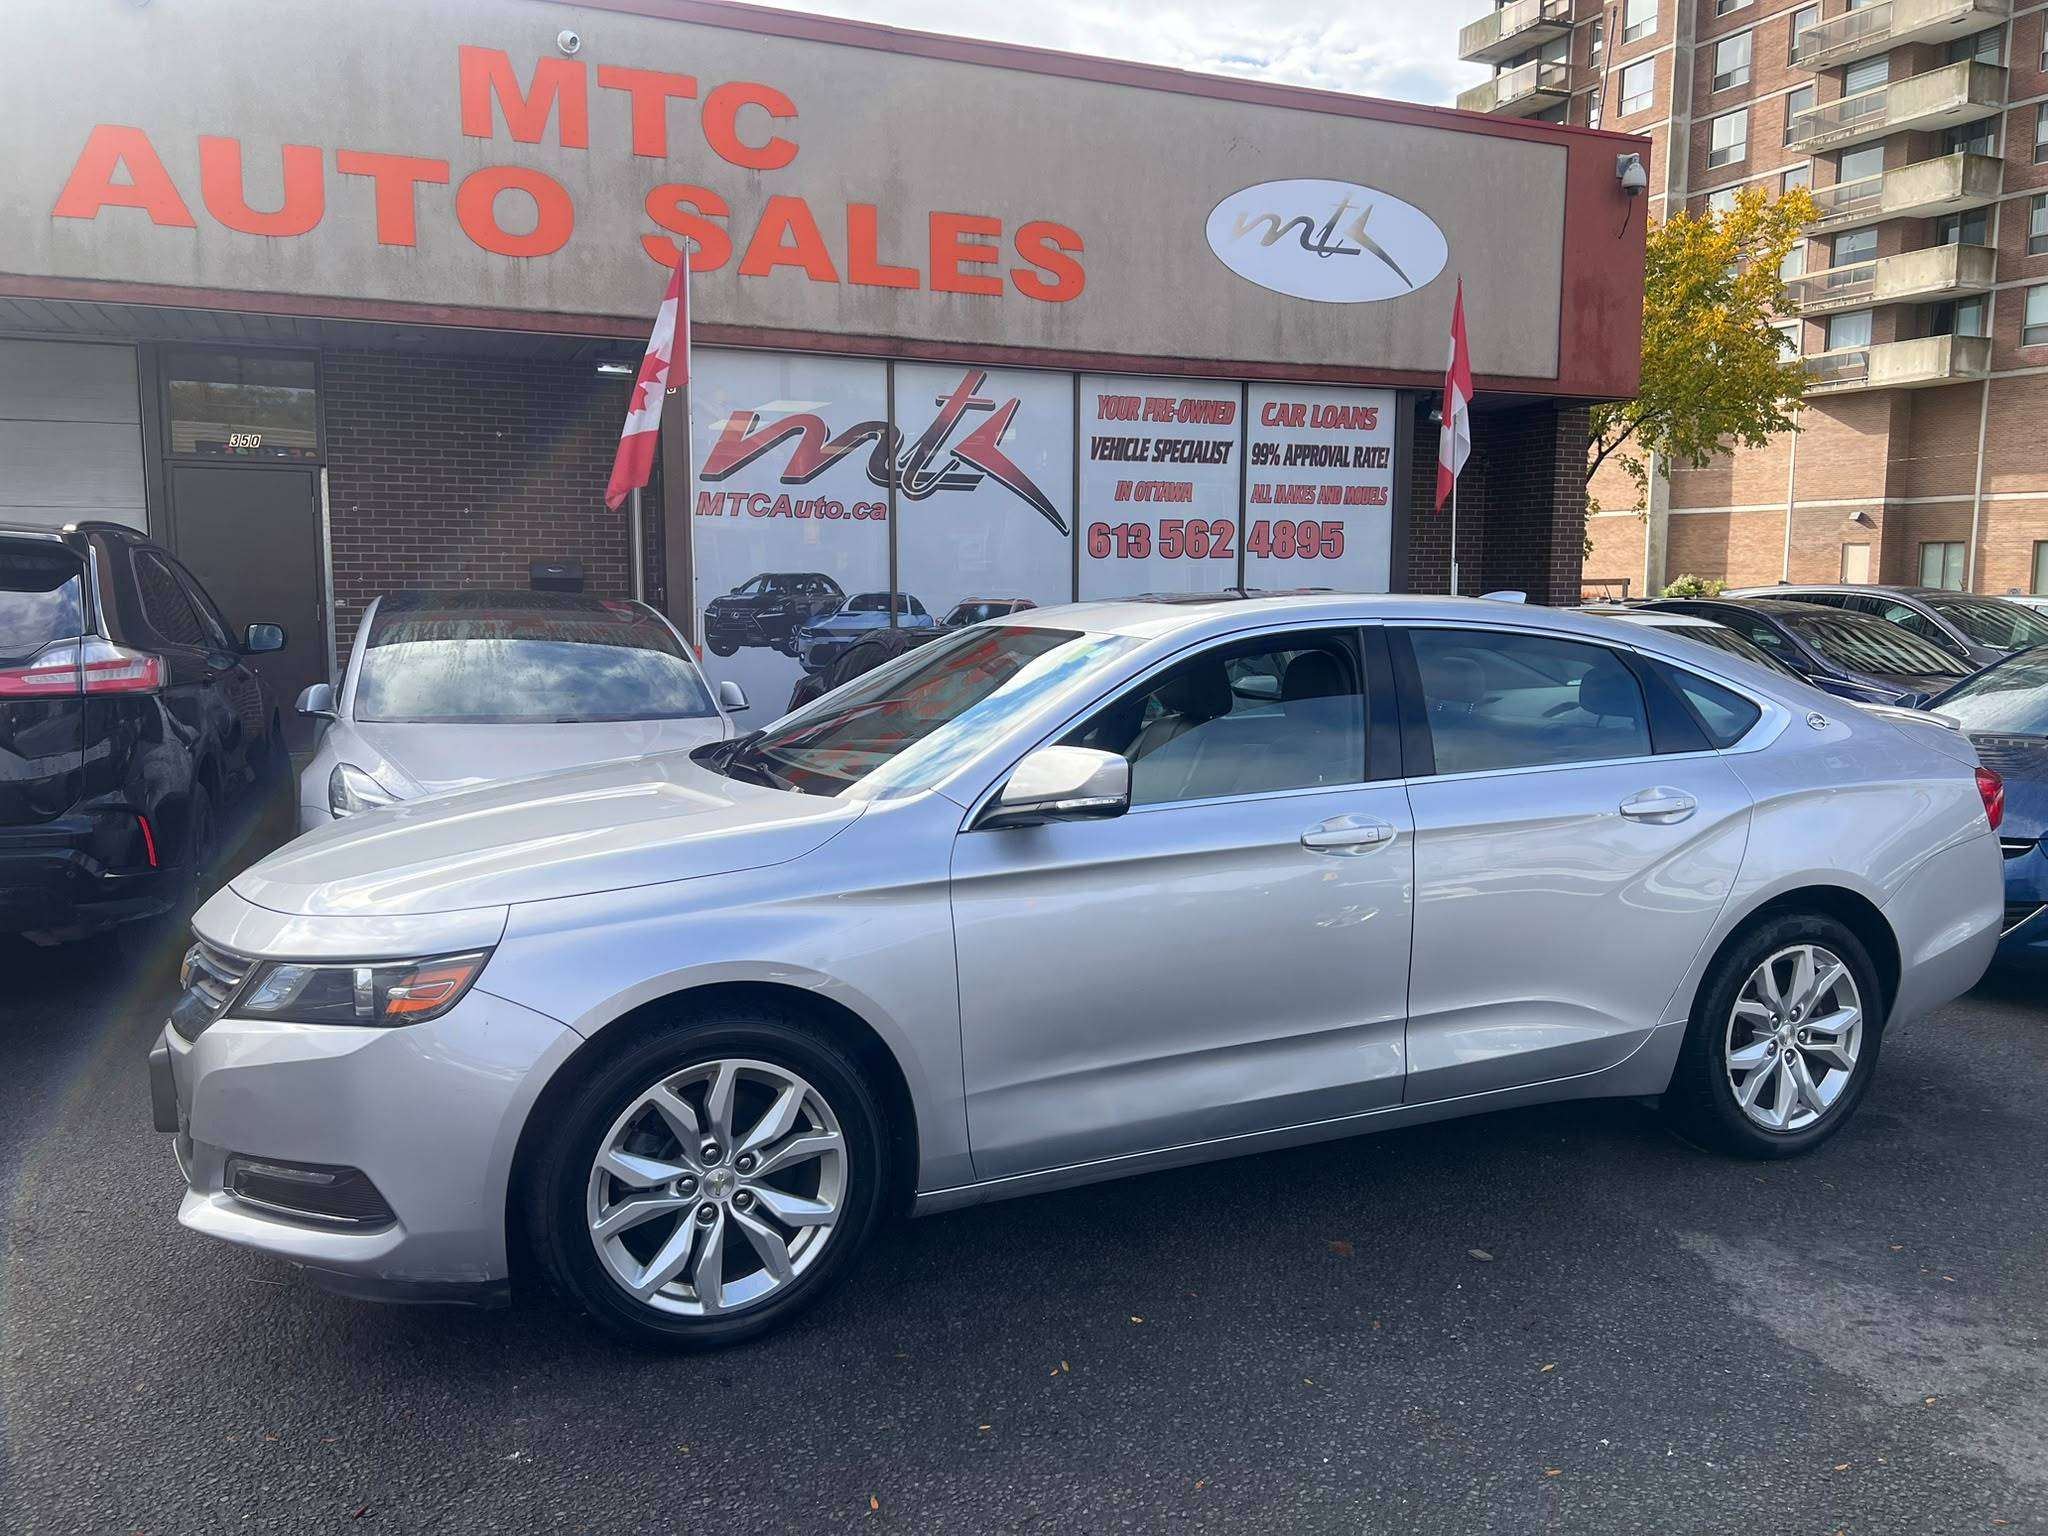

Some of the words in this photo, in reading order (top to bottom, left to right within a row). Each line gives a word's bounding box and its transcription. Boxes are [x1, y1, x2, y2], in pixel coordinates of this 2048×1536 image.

[458, 44, 799, 170] MTC
[51, 124, 575, 258] AUTO
[640, 183, 1086, 302] SALES
[1098, 395, 1141, 421] YOUR
[1142, 398, 1236, 425] PRE-OWNED
[1261, 402, 1307, 428] CAR
[1310, 404, 1378, 431] LOANS
[230, 435, 261, 447] 350
[1090, 436, 1151, 462] VEHICLE
[1151, 439, 1234, 464] SPECIALIST
[1251, 442, 1281, 466] 99%
[1282, 443, 1351, 468] APPROVAL
[1352, 446, 1390, 469] RATE!
[1114, 480, 1133, 502] IN
[1134, 481, 1193, 503] OTTAWA
[1250, 483, 1273, 504] ALL
[1273, 484, 1317, 505] MAKES
[1317, 485, 1343, 505] AND
[1342, 486, 1389, 506] MODELS
[696, 492, 887, 521] MTCAuto.ca
[1087, 522, 1151, 560] 613
[1158, 519, 1235, 560] 562
[1246, 520, 1345, 560] 4895
